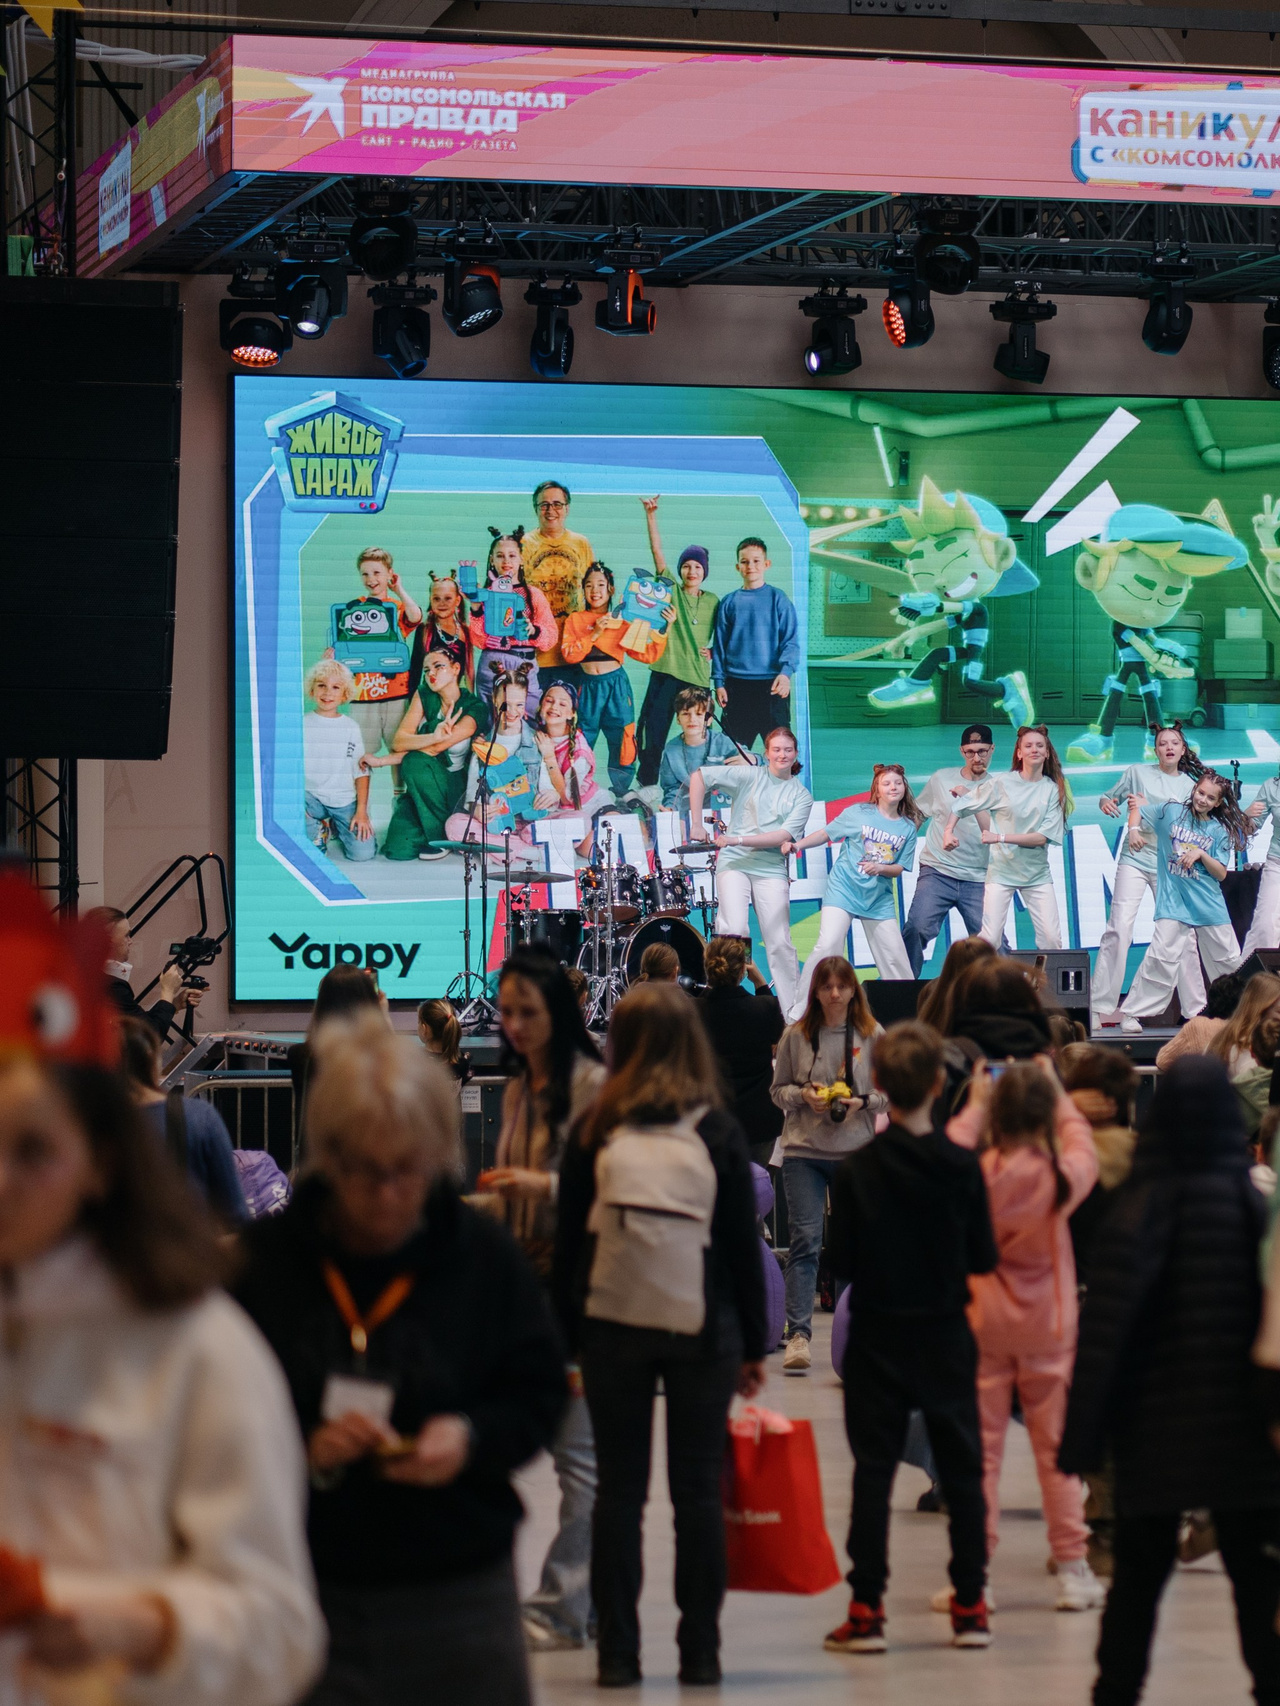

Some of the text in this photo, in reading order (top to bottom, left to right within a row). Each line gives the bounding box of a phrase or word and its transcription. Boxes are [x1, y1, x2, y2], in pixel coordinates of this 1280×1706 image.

[361, 85, 567, 109] КОМСОМОЛЬСКАЯ
[361, 104, 519, 135] ПРАВДА
[361, 134, 518, 150] САЙТ РАДИО ГАЗЕТА
[286, 412, 384, 454] ЖИВОЙ
[290, 457, 379, 496] ГАРАЖ
[268, 932, 422, 978] Yappy
